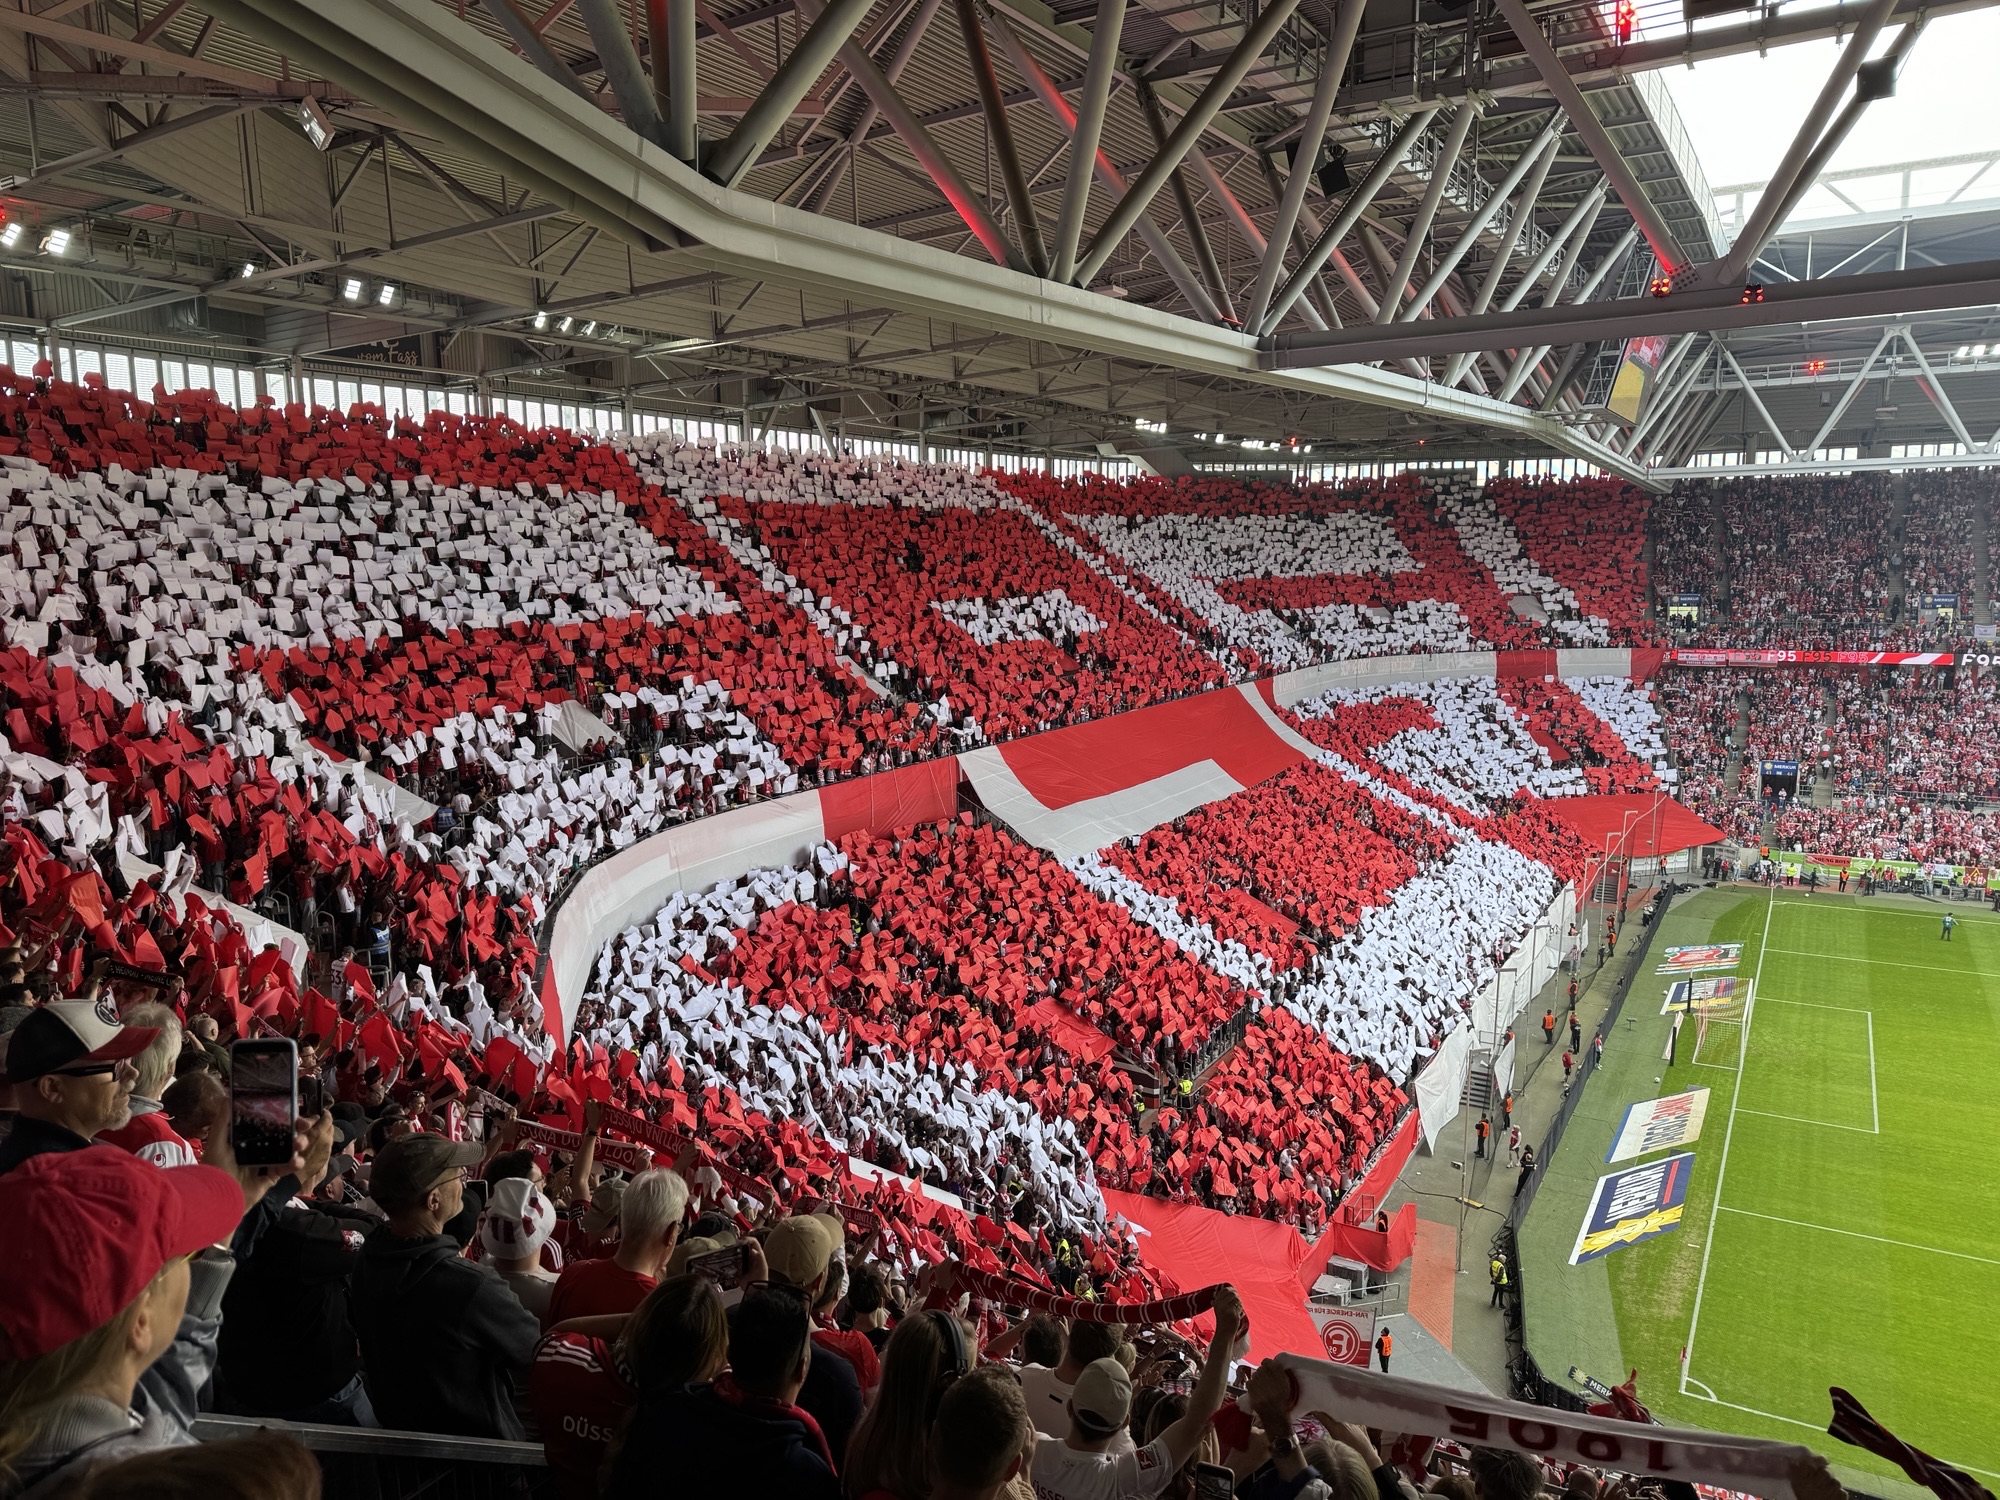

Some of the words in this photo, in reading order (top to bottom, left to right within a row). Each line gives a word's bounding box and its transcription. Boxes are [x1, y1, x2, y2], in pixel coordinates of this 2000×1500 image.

[387, 346, 419, 366] Fass
[1802, 651, 1832, 662] F95
[1837, 651, 1869, 663] F95
[1961, 653, 2000, 667] F95
[1605, 1164, 1666, 1223] MERKUR
